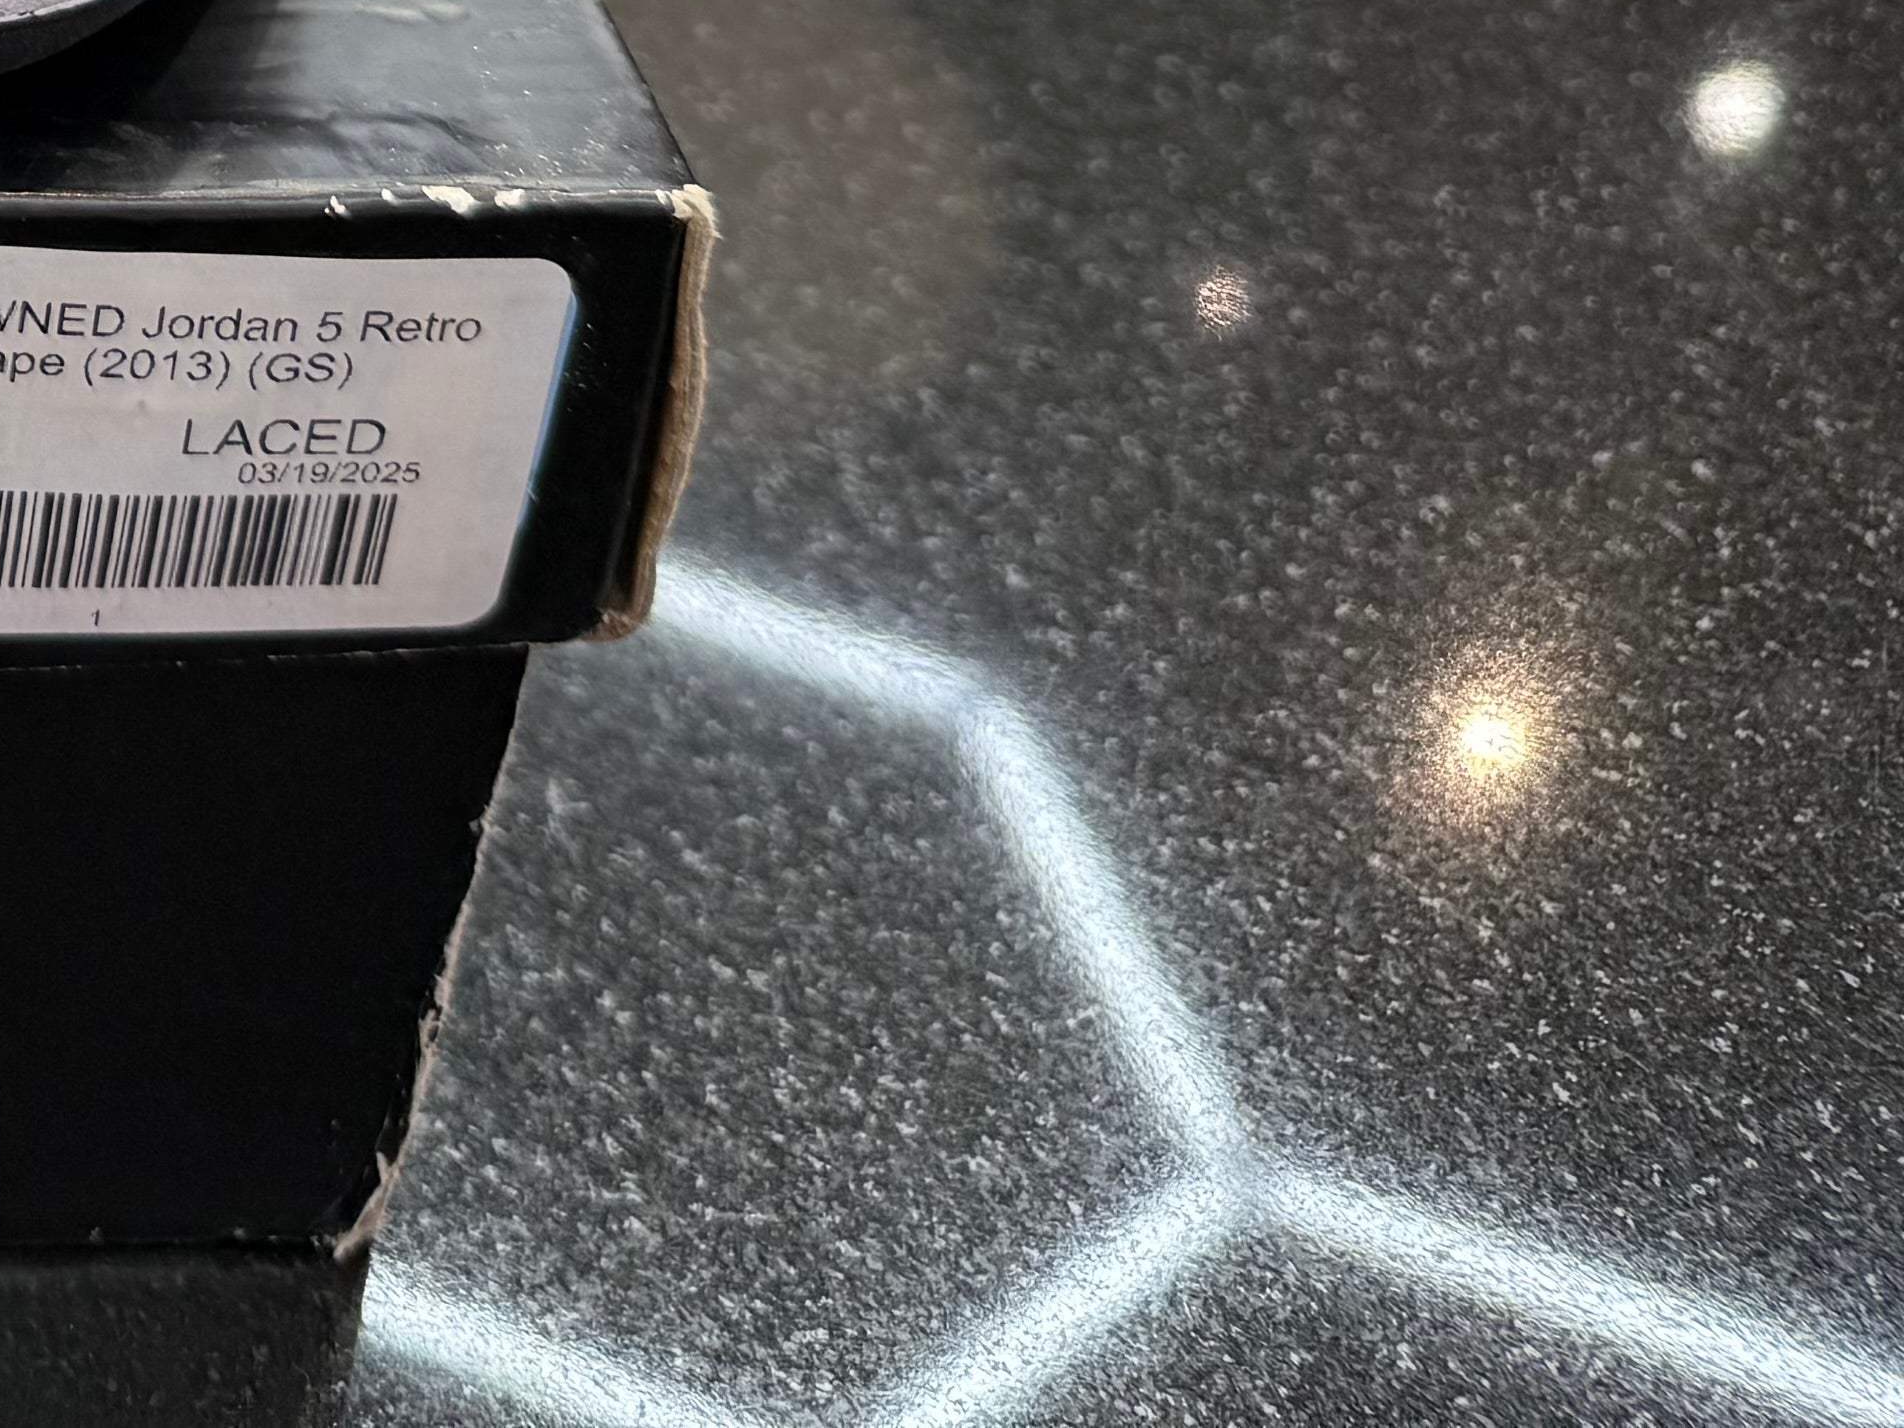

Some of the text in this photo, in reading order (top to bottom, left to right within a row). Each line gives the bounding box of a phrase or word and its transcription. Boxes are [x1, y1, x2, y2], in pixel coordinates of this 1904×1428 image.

[141, 305, 299, 343] Jordan
[315, 311, 344, 343] 5
[360, 310, 482, 343] Retro
[83, 347, 231, 391] (2013)
[248, 351, 354, 392] (GS)
[181, 418, 387, 457] LACED
[237, 461, 422, 486] 03/19/2025
[90, 609, 101, 627] 1
